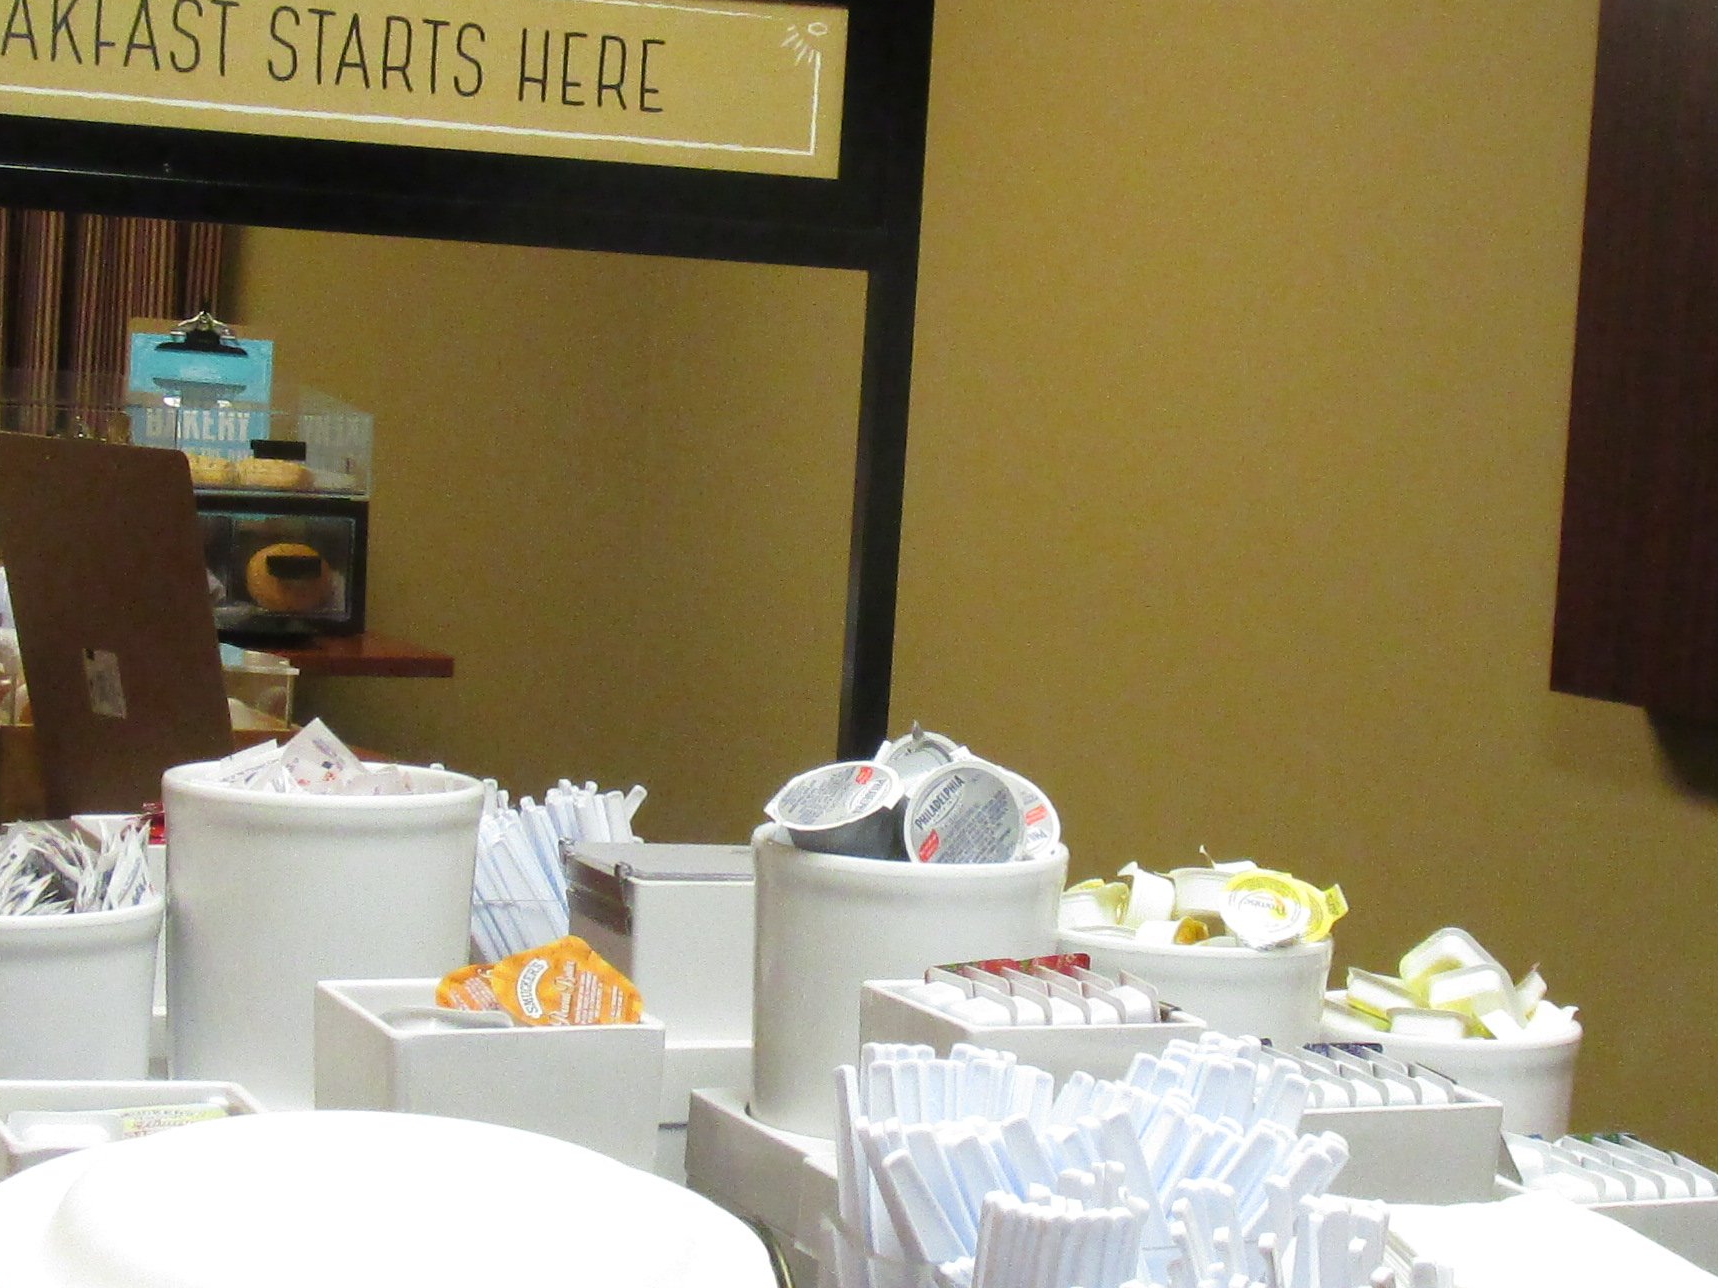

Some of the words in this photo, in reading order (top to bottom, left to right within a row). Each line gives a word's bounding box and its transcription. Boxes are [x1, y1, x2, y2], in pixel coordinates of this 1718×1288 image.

[267, 4, 486, 98] STARTS
[518, 27, 666, 113] HERE
[146, 407, 250, 441] BAKERY
[914, 774, 966, 830] PHILADELPHIA
